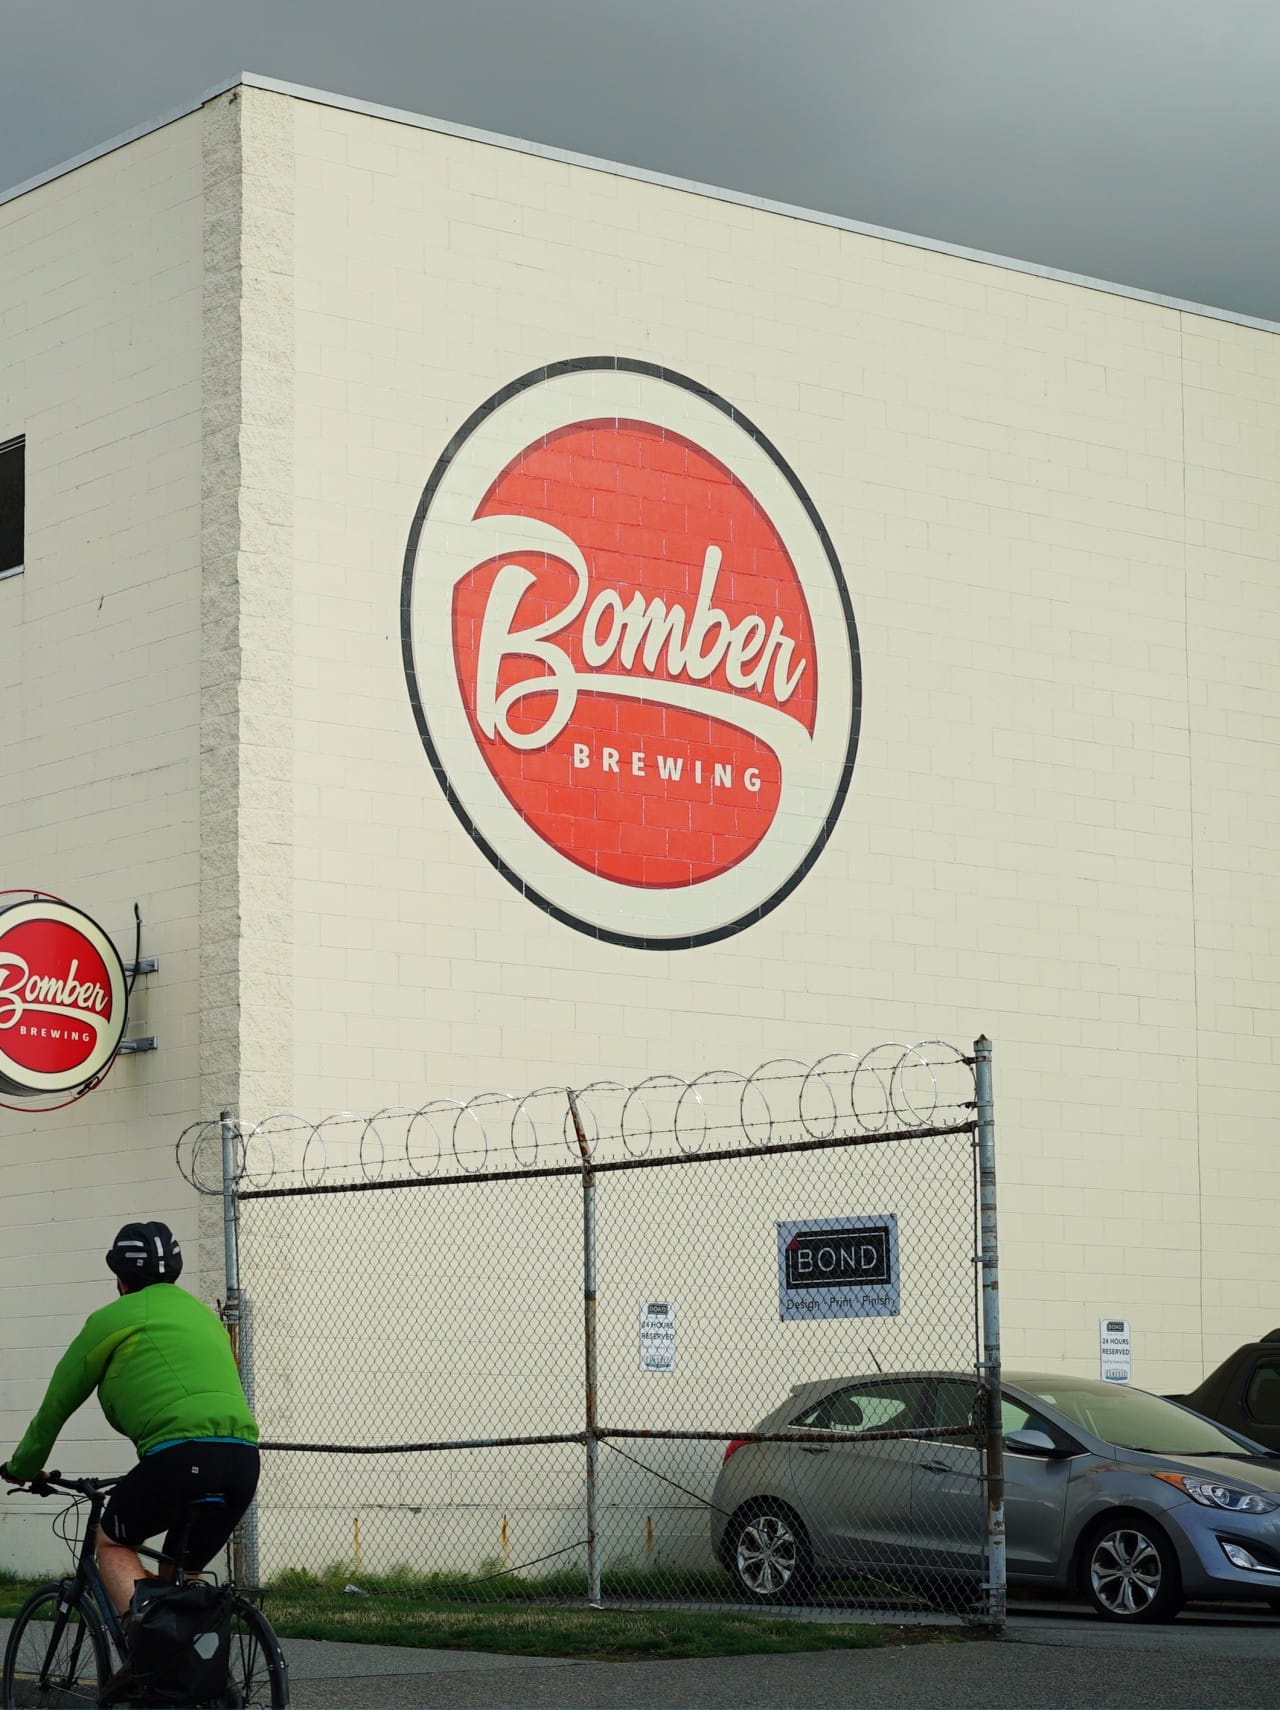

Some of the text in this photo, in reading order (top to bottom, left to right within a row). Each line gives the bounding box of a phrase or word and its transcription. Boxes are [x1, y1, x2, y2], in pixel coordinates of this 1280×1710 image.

[468, 514, 807, 750] Bomber
[573, 742, 762, 793] BREWING
[19, 1025, 90, 1042] BREWING
[797, 1245, 878, 1274] BOND
[786, 1295, 891, 1312] Design Print Finish
